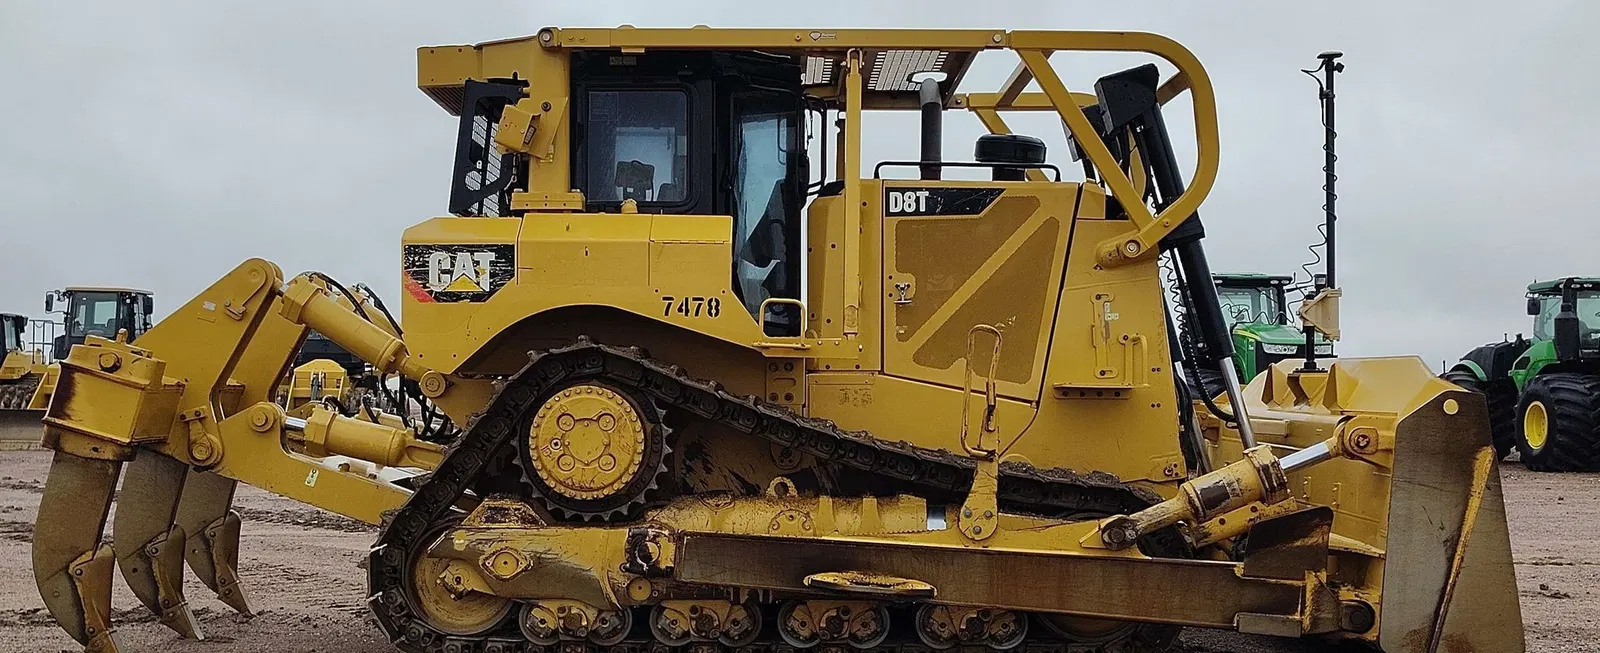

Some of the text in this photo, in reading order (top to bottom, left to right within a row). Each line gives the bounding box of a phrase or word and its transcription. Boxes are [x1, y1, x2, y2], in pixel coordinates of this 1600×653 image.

[889, 191, 929, 213] D8T
[429, 252, 496, 291] CAT
[662, 297, 721, 318] 7478
